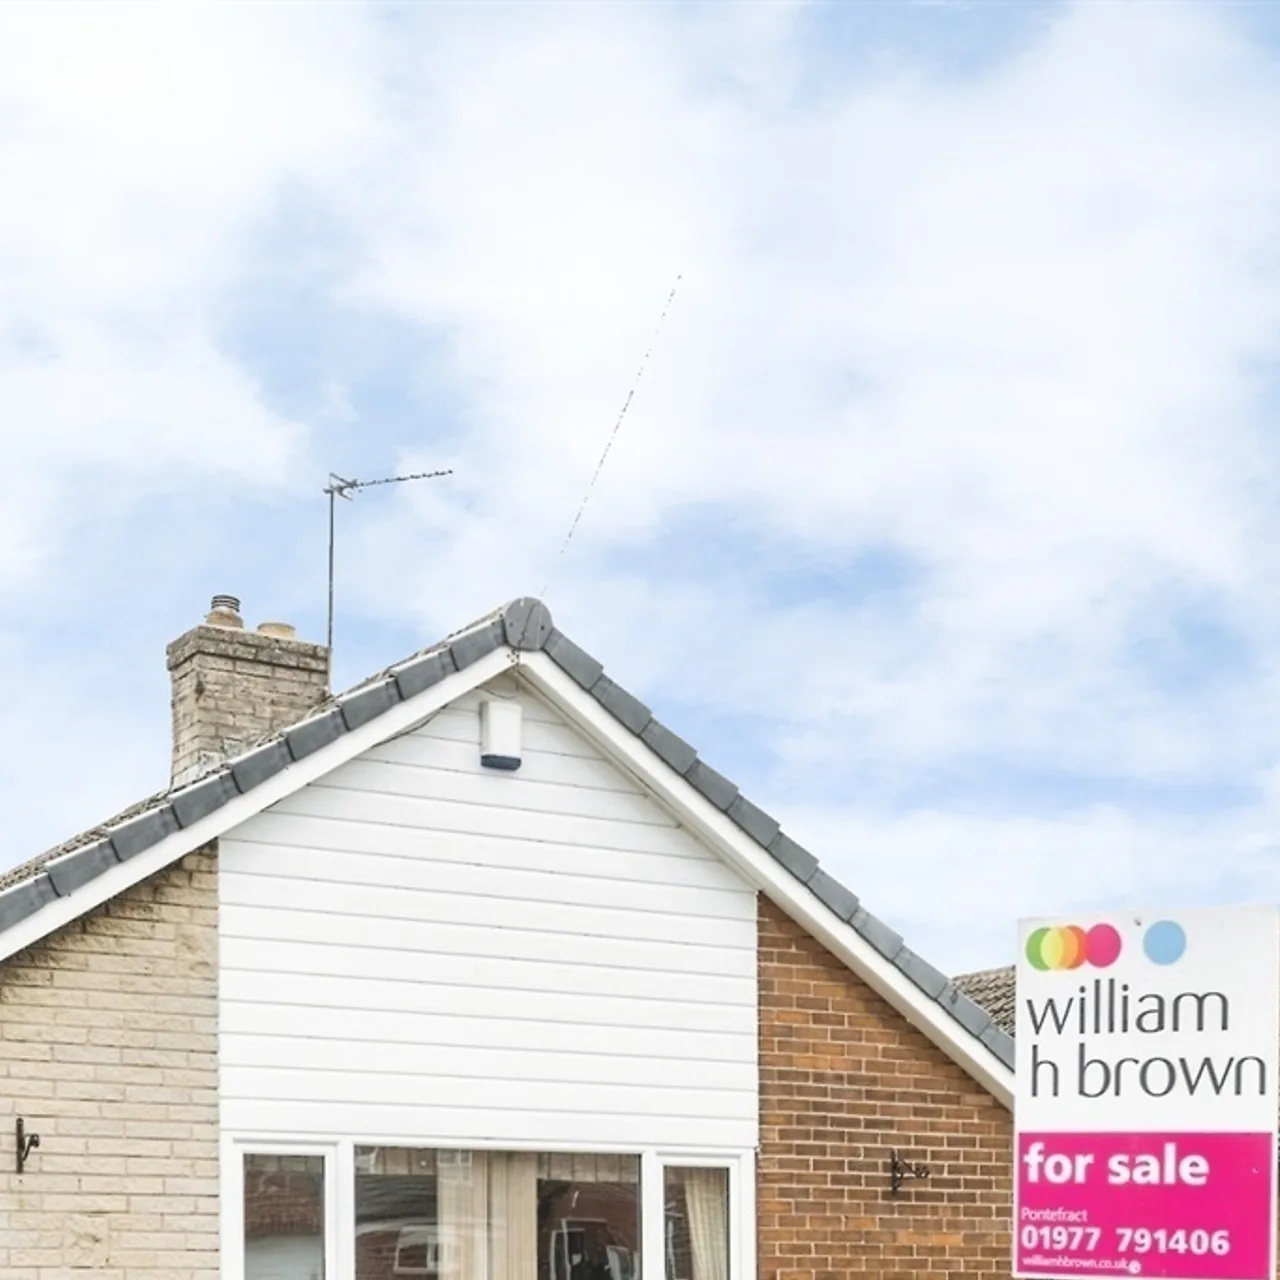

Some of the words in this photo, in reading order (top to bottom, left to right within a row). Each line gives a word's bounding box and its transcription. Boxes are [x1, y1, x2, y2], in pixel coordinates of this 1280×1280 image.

[1026, 978, 1228, 1035] william
[1032, 1044, 1059, 1097] h
[1078, 1042, 1266, 1098] brown
[1023, 1142, 1094, 1184] for
[1108, 1142, 1210, 1186] sale
[1021, 1207, 1088, 1222] Pontefract
[1021, 1225, 1101, 1251] 01977
[1115, 1227, 1230, 1256] 791406
